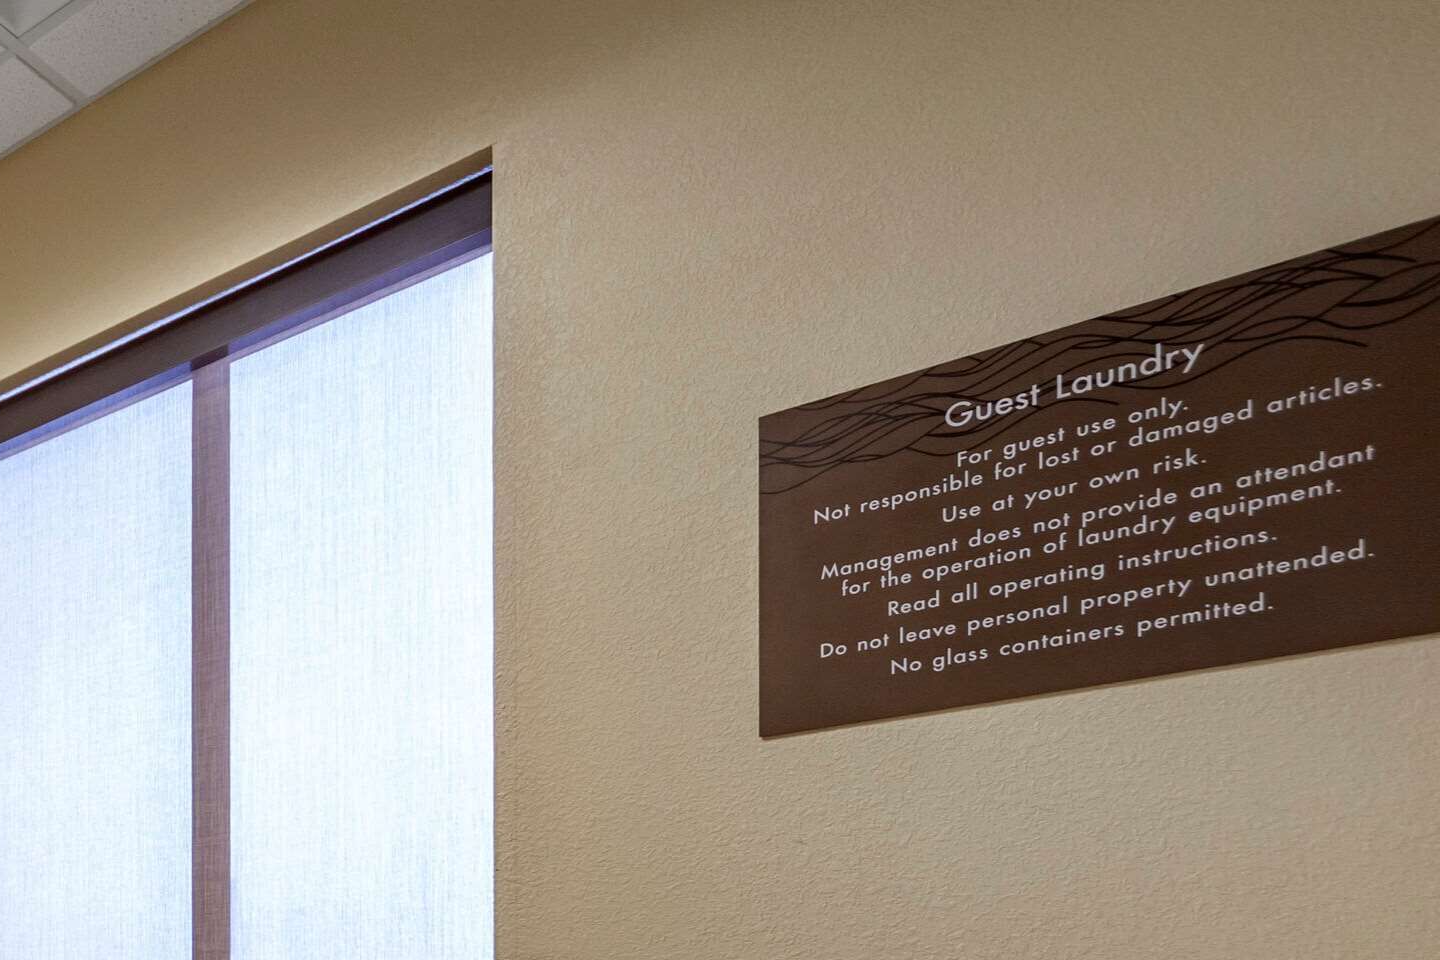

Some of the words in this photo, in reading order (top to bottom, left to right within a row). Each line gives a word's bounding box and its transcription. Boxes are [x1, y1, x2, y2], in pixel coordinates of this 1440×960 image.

[945, 384, 1040, 427] Guest
[1056, 343, 1204, 399] Laundry
[813, 503, 851, 525] Not
[860, 470, 983, 513] responsible
[994, 461, 1027, 480] for
[1038, 447, 1079, 470] lost
[1090, 440, 1116, 457] or
[1128, 399, 1253, 447] damaged
[1267, 377, 1383, 413] articles.
[957, 449, 992, 468] For
[1003, 427, 1065, 460] guest
[1076, 418, 1116, 437] use
[1128, 397, 1188, 424] only.
[820, 538, 958, 587] Management
[968, 526, 1022, 548] does
[1033, 513, 1070, 534] not
[1081, 487, 1177, 528] provide
[1190, 482, 1222, 499] an
[1236, 445, 1374, 489] attendant
[942, 505, 981, 523] Use
[991, 494, 1014, 512] at
[1024, 482, 1078, 509] your
[1089, 468, 1139, 489] own
[1153, 448, 1207, 474] risk.
[841, 578, 871, 597] for
[880, 572, 912, 589] the
[921, 547, 1031, 582] operation
[1043, 531, 1067, 554] of
[1078, 514, 1176, 547] laundry
[1188, 479, 1341, 523] equipment.
[887, 589, 940, 617] Read
[950, 581, 978, 604] all
[989, 563, 1105, 599] operating
[1118, 531, 1277, 571] instructions.
[819, 642, 848, 659] Do
[857, 633, 890, 652] not
[899, 623, 957, 644] leave
[967, 595, 1068, 636] personal
[1080, 579, 1192, 615] property
[1205, 539, 1374, 587] unattended.
[890, 657, 923, 675] No
[932, 647, 989, 672] glass
[999, 624, 1124, 656] containers
[1137, 591, 1273, 637] permitted.
